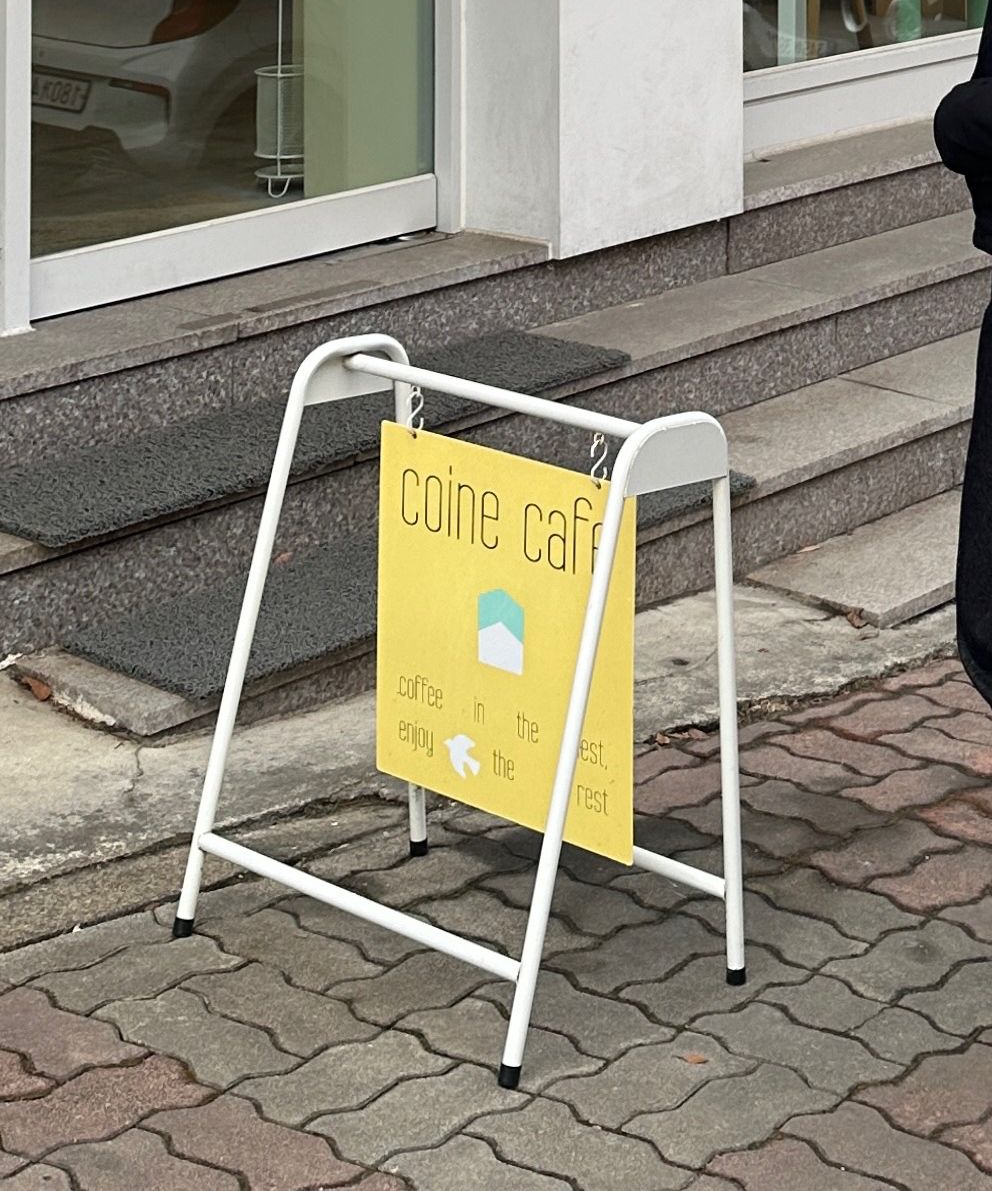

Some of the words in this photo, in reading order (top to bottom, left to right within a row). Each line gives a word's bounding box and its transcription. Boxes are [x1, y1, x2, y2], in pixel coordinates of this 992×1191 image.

[401, 465, 499, 550] coine
[398, 674, 443, 710] coffee
[473, 696, 485, 725] in
[516, 712, 539, 743] the
[398, 719, 434, 758] enjoy
[492, 749, 515, 781] the
[576, 782, 609, 816] rest
